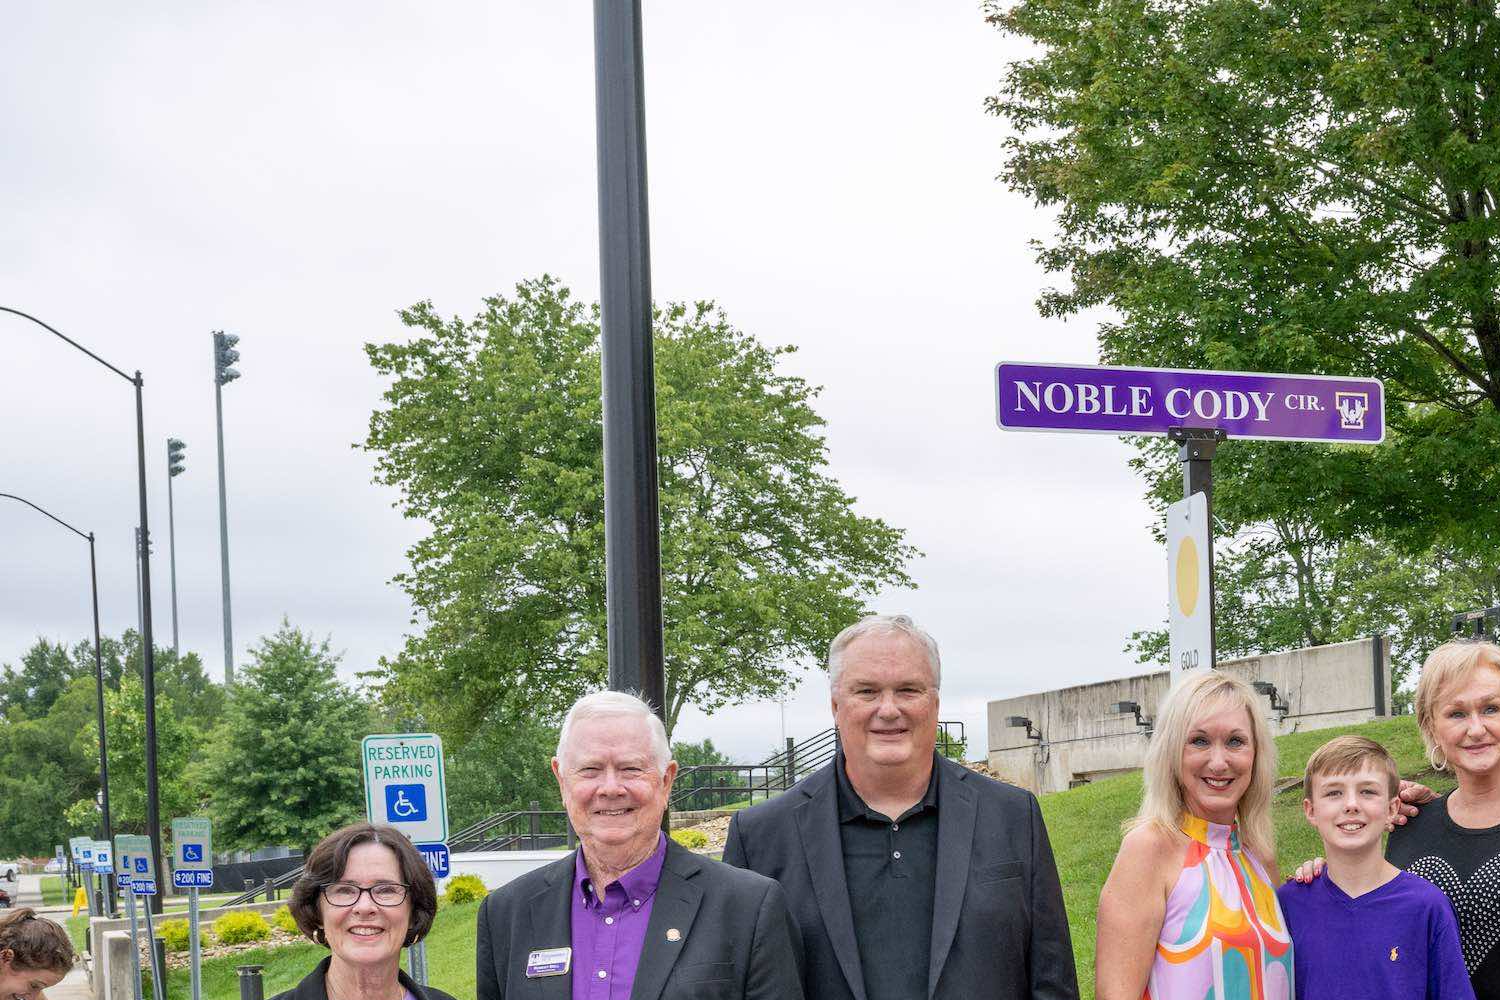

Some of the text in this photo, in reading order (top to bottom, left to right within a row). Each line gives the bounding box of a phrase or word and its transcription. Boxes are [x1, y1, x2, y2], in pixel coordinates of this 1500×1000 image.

[1013, 381, 1325, 422] NOBLE CODY CIR.
[1181, 649, 1199, 671] GOLD
[368, 745, 436, 761] RESERVED
[374, 764, 433, 779] PARKING
[175, 872, 211, 884] $200 FINE
